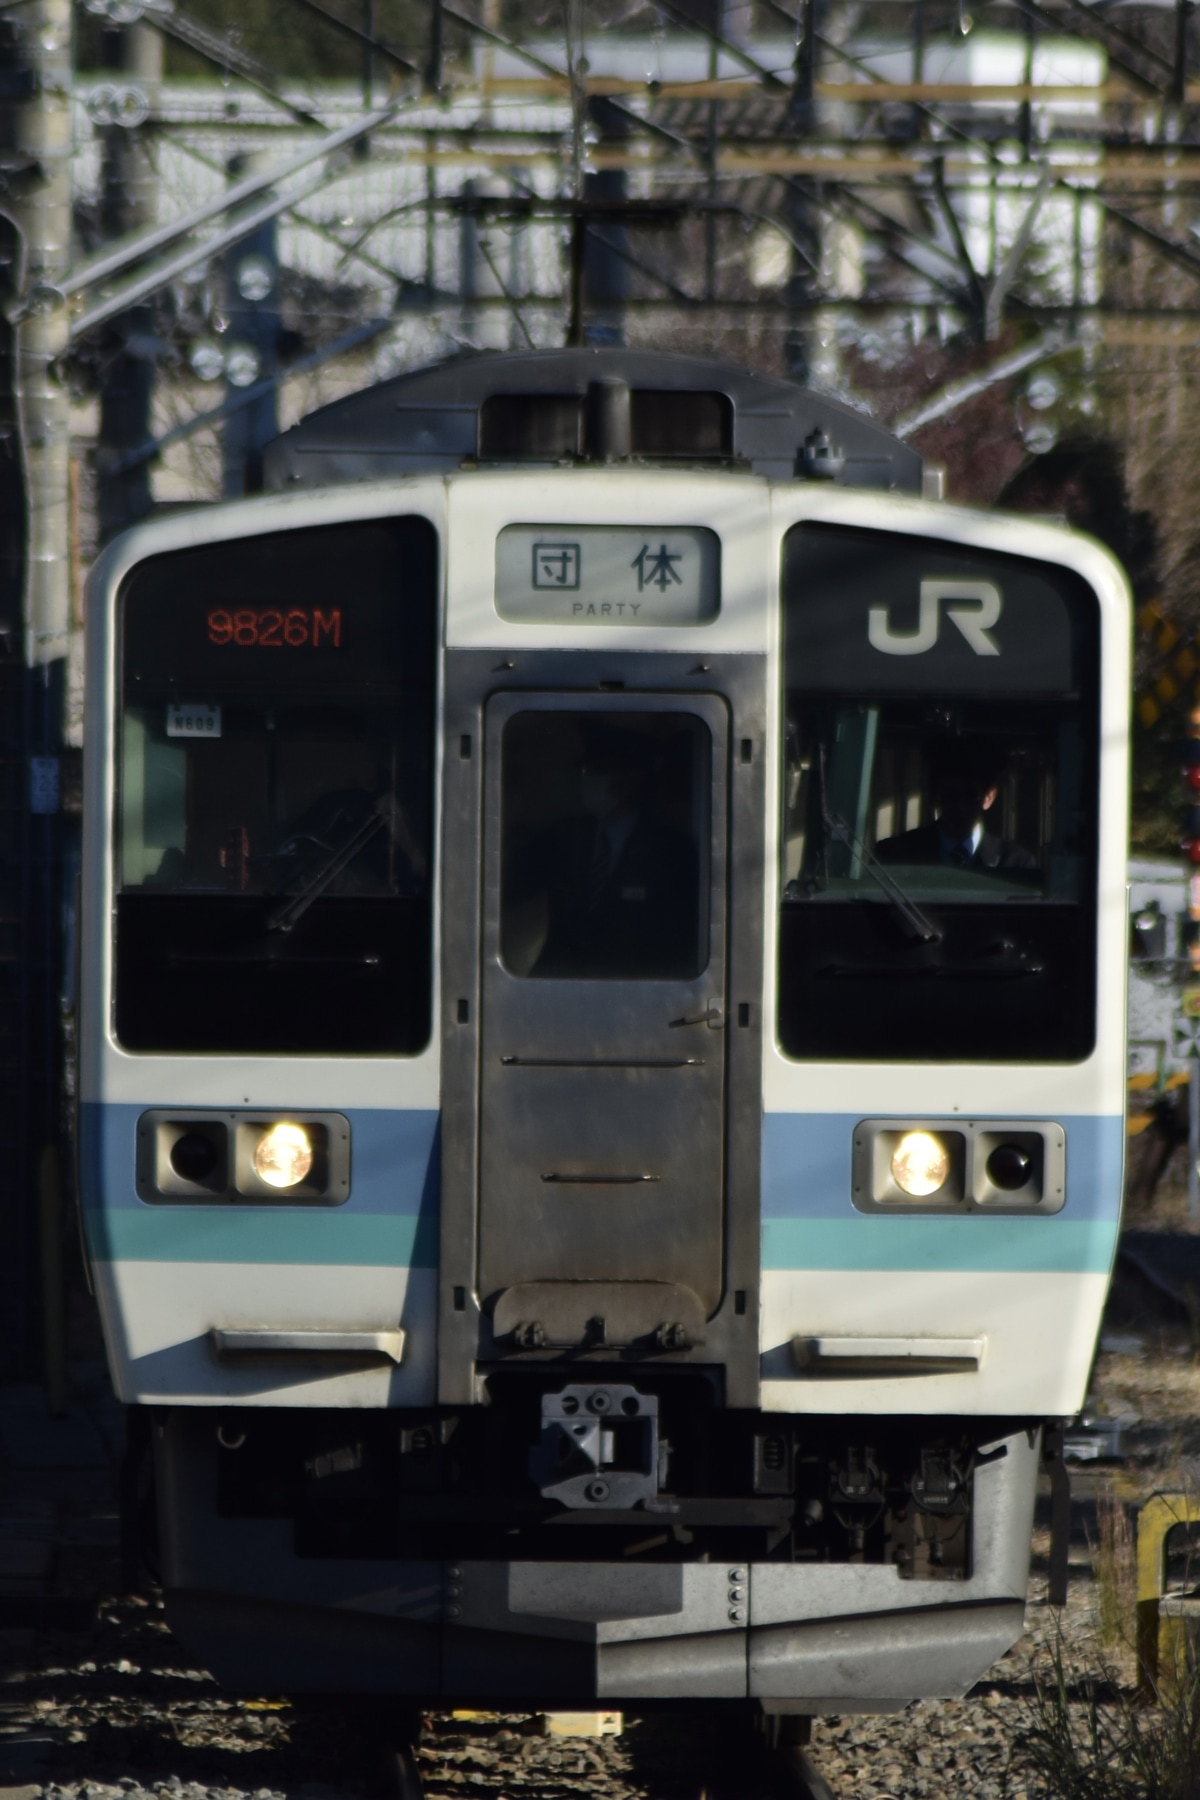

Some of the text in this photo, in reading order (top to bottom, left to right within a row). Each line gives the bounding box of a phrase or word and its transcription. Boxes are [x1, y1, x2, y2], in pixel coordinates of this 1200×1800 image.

[531, 542, 684, 593] 団体
[207, 610, 342, 647] 9826M
[571, 602, 642, 617] PARTY
[867, 580, 1002, 656] JR
